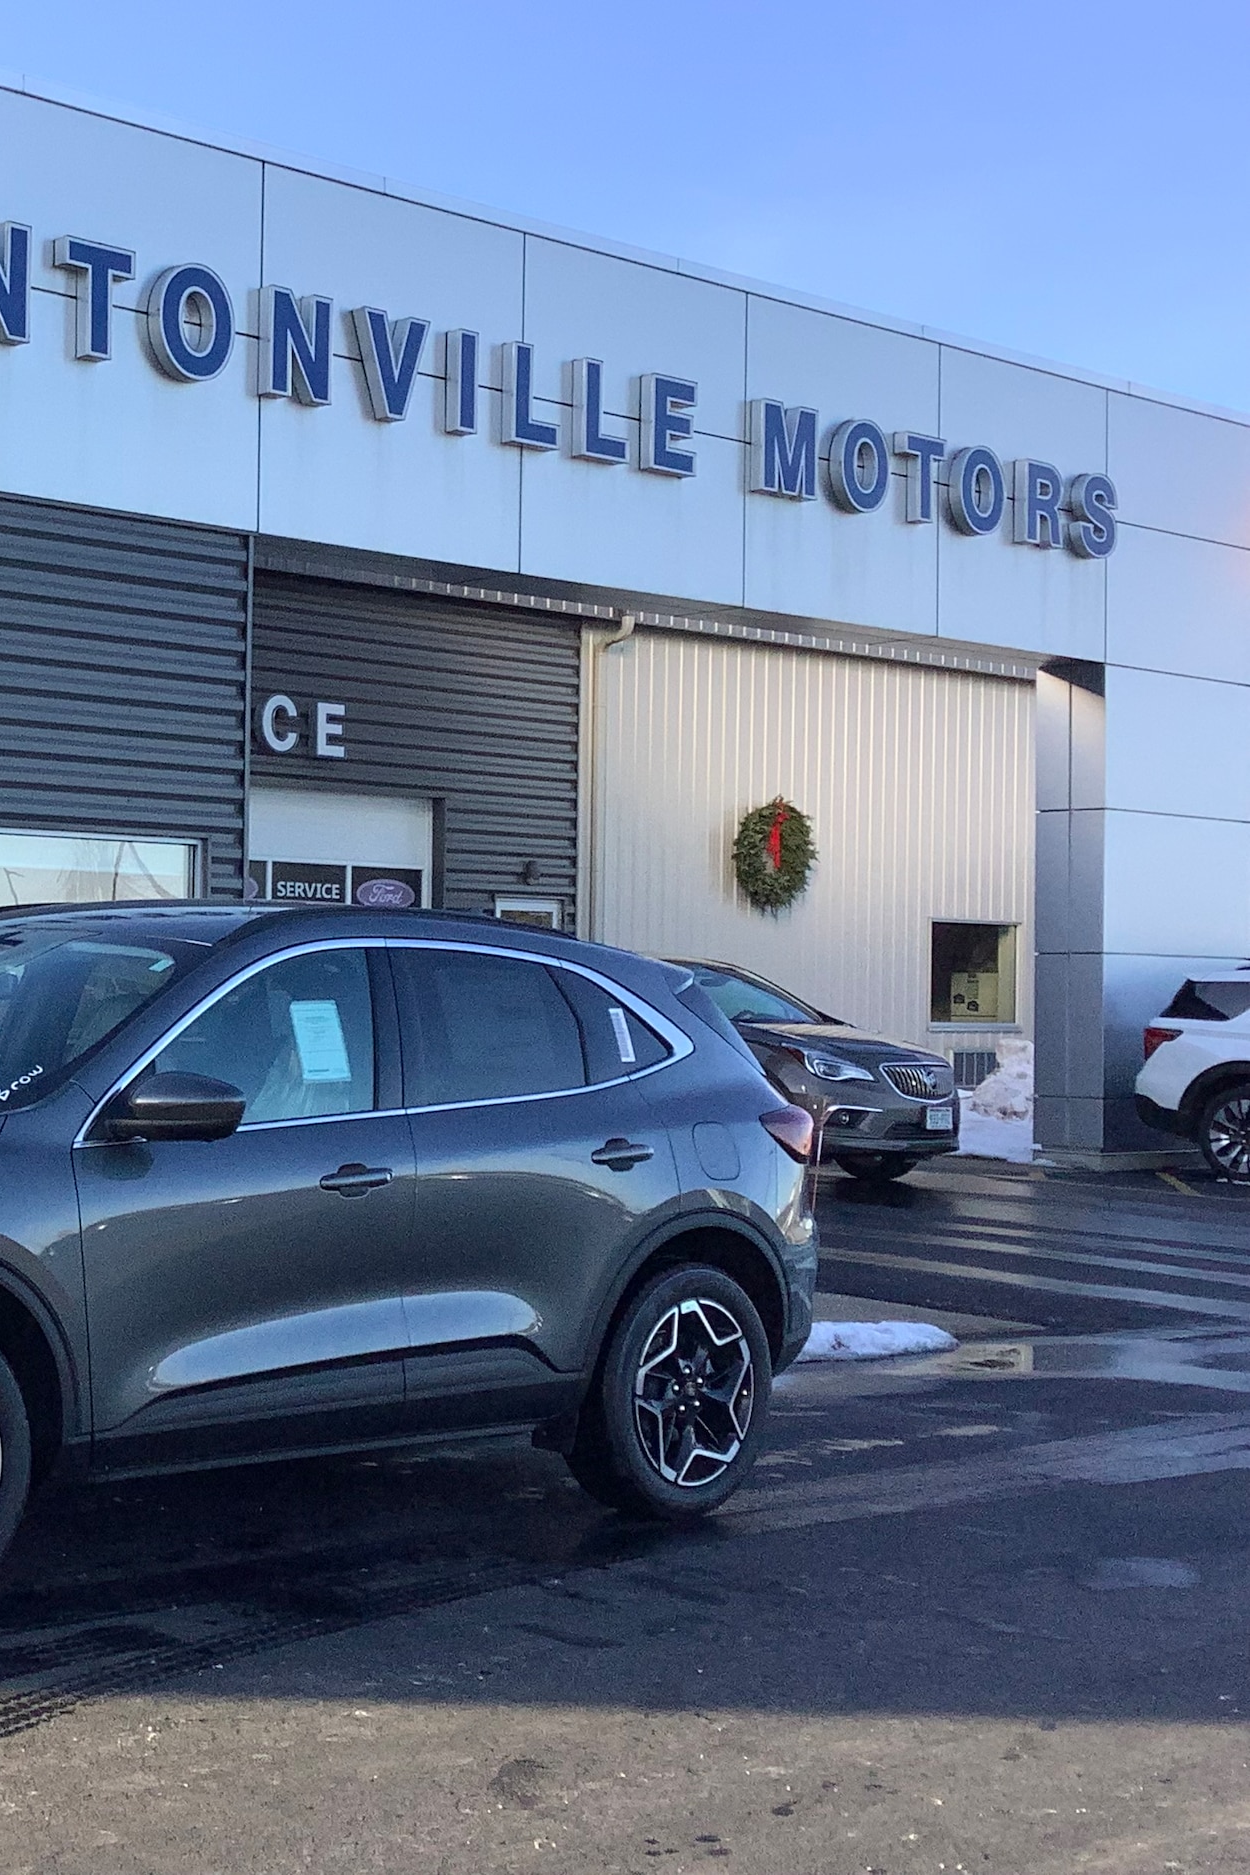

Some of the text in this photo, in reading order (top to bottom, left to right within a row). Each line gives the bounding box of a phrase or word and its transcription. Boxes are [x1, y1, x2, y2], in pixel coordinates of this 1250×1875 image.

[751, 398, 1120, 559] MOTORS
[276, 881, 341, 899] SERVICE
[368, 884, 403, 904] Ford
